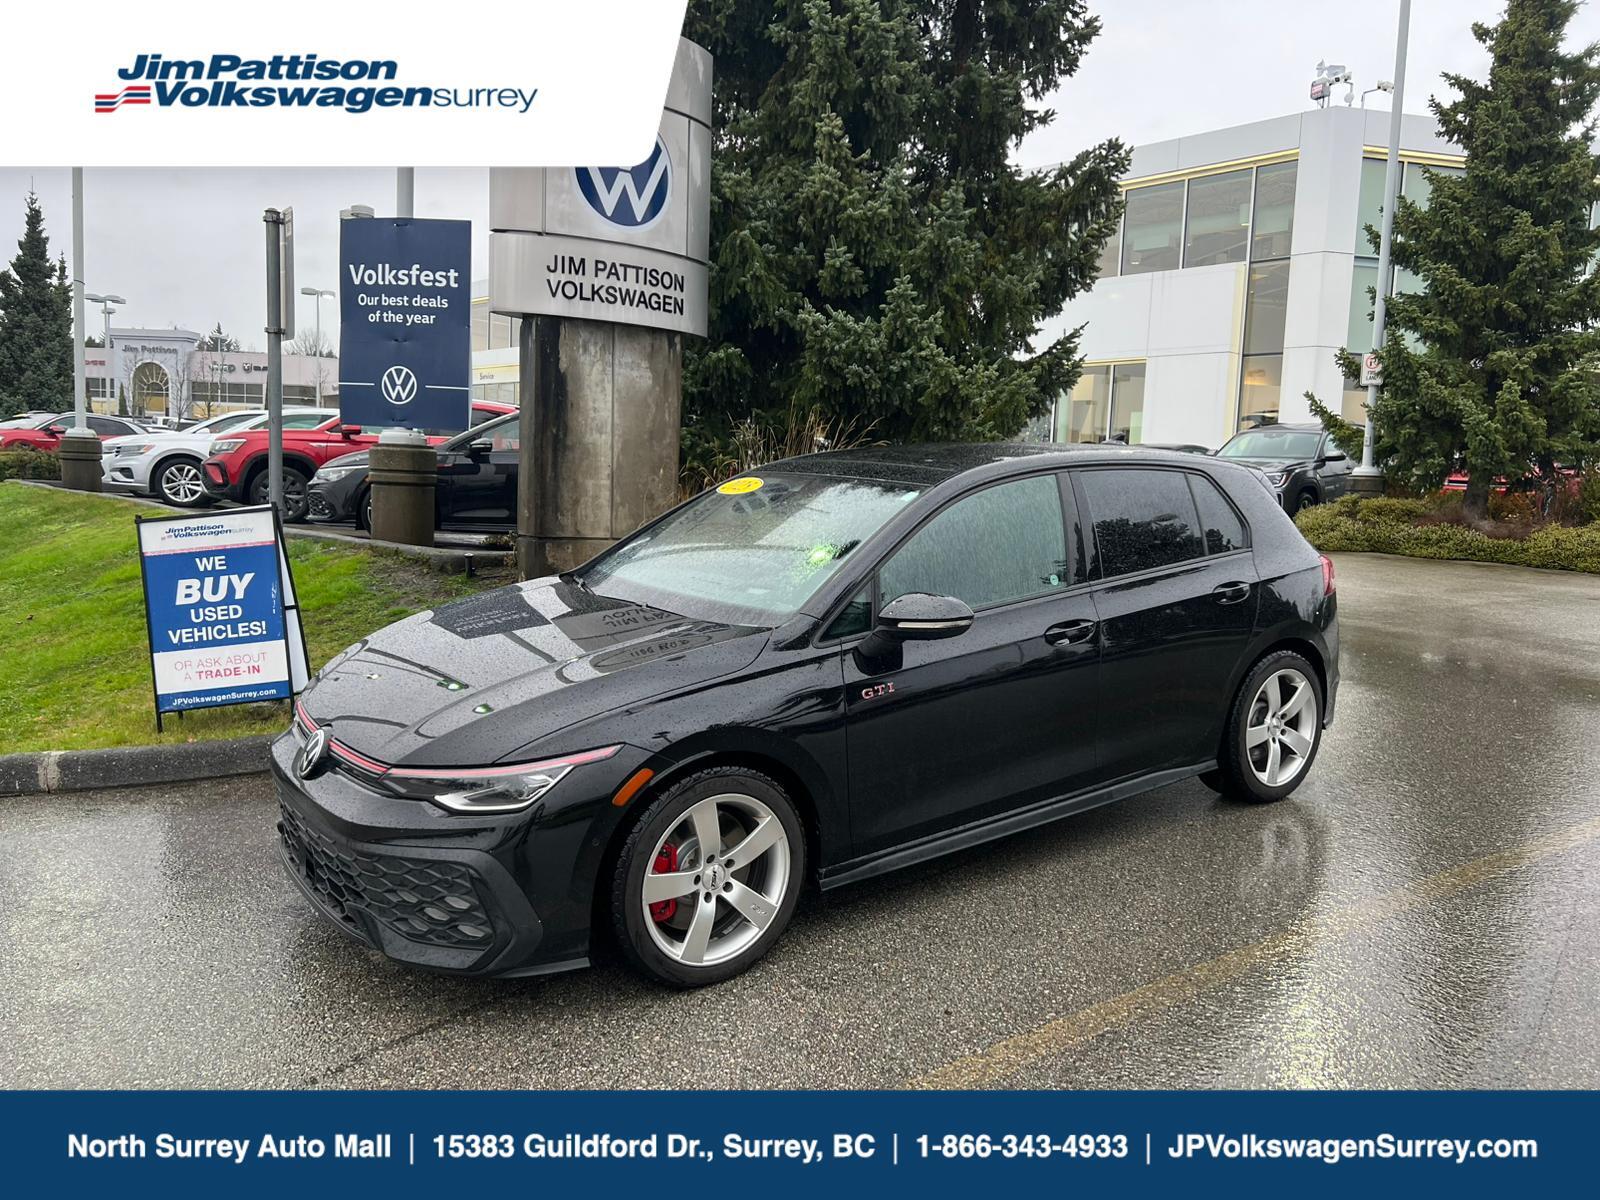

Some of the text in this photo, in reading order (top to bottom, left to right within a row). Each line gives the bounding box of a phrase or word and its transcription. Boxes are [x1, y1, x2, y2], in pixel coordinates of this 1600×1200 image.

[349, 264, 459, 287] Volksfest
[547, 255, 684, 293] JIM PATTISON
[357, 293, 448, 308] Our best deals
[546, 278, 684, 316] VOLKSWAGEN
[368, 311, 436, 325] of the year
[122, 344, 178, 353] Jim Pattison
[165, 524, 224, 535] Jim Pattison
[195, 556, 227, 572] WE
[175, 572, 255, 606] BUY
[190, 605, 242, 623] USED
[168, 620, 267, 645] VEHICLES!
[174, 652, 267, 671] OR ASK ABOUT
[184, 665, 261, 681] A TRADE-IN
[172, 688, 277, 706] JPVolkswagenSurrey.com
[861, 682, 895, 699] GTI
